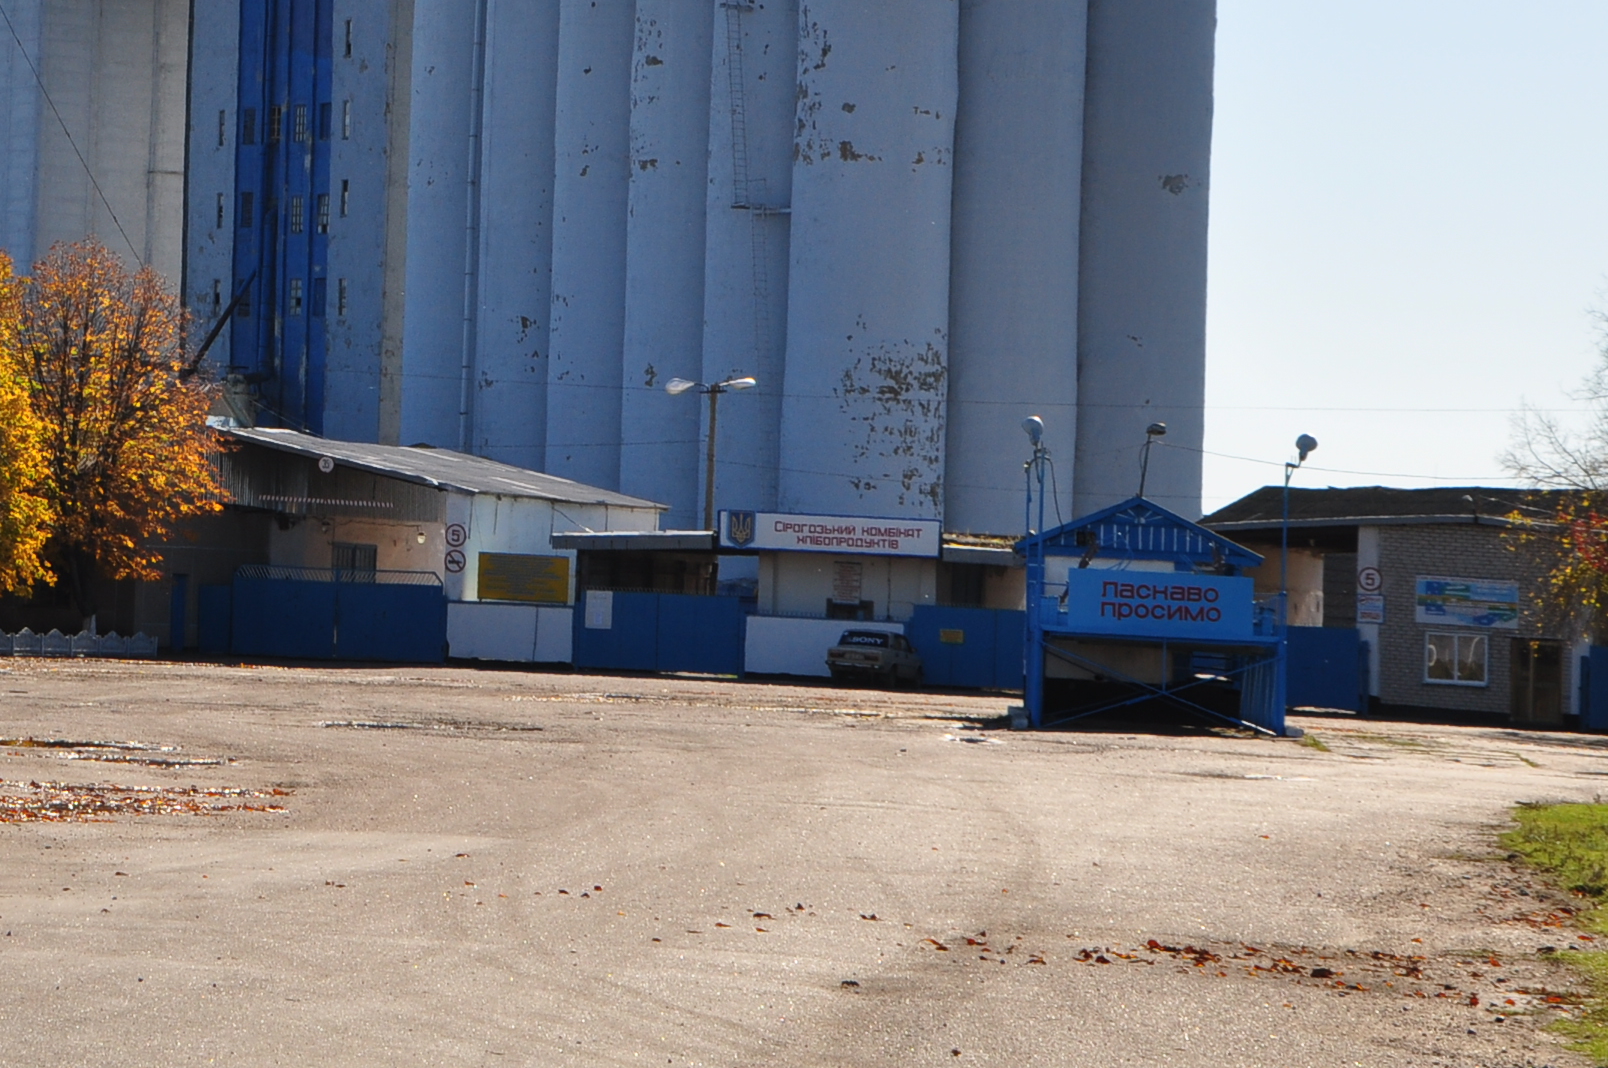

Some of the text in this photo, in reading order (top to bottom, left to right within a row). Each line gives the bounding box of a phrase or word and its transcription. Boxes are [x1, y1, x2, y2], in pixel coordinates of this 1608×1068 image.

[451, 529, 461, 542] 5
[774, 520, 923, 539] СІРОГОЗЬКИЙ КОМБІНАТ
[796, 534, 900, 550] ХЛІБОПРОДУКТІВ
[1364, 573, 1376, 586] 5
[1100, 601, 1222, 623] просимо
